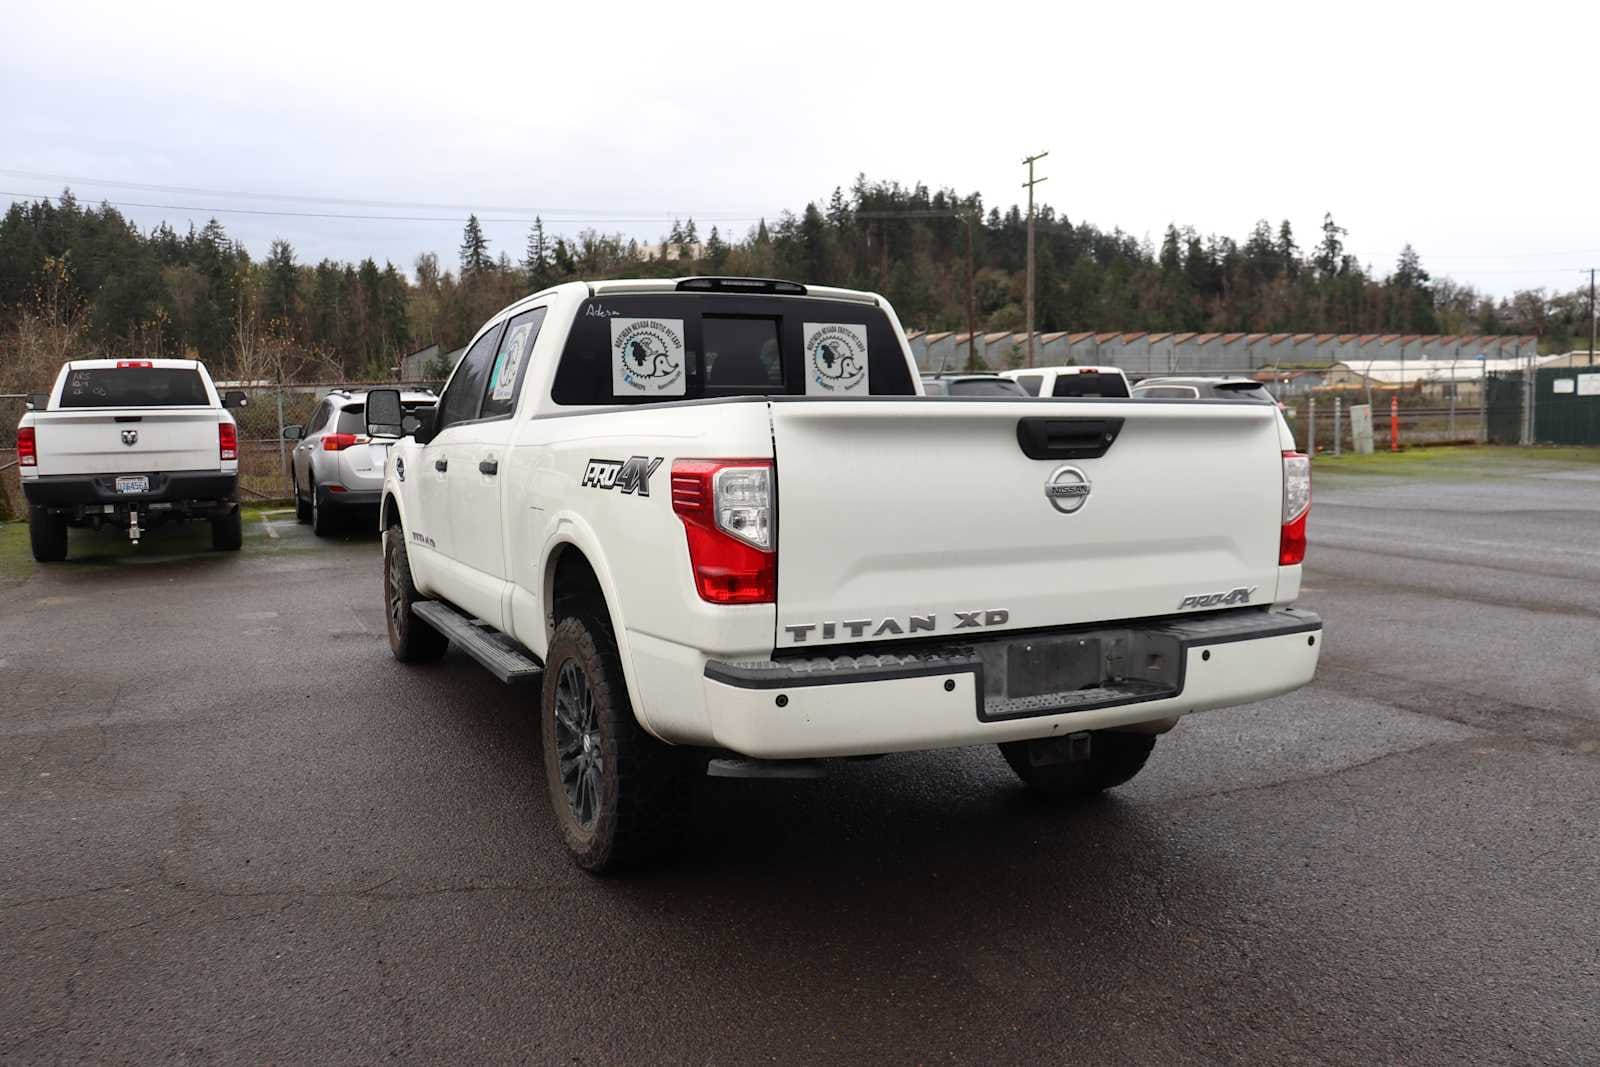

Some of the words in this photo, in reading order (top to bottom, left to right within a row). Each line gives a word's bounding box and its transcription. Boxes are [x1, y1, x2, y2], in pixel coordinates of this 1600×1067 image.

[631, 321, 649, 332] NEVADA
[650, 321, 666, 333] EXOTIC
[1051, 486, 1088, 496] NISSAN
[785, 613, 936, 642] TITAN
[952, 608, 1009, 629] XD
